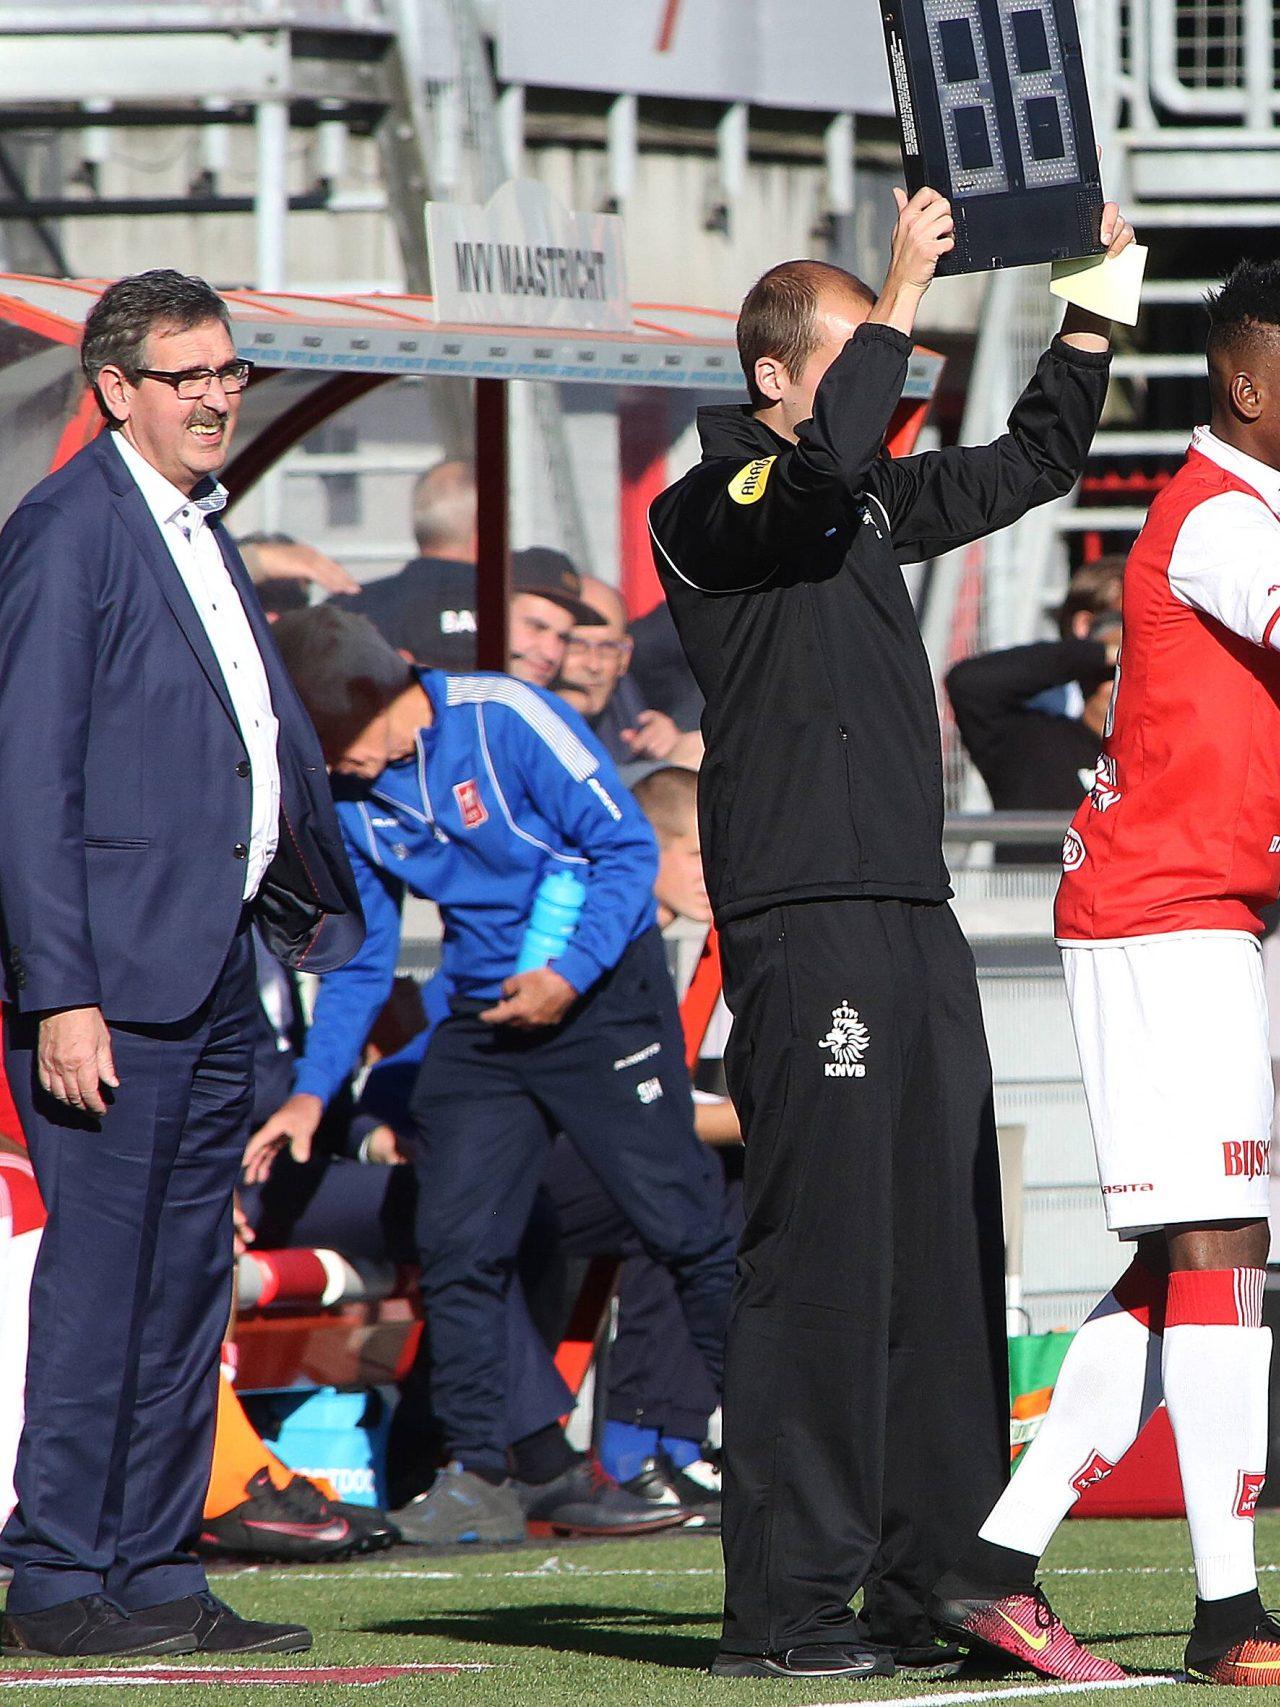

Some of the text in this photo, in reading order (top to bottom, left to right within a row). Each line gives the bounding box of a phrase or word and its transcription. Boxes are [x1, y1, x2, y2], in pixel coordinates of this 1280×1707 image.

[455, 242, 606, 301] MVV MAASTRICHT
[441, 609, 477, 634] BA
[824, 1063, 866, 1078] KNVB
[1101, 1182, 1154, 1195] asita
